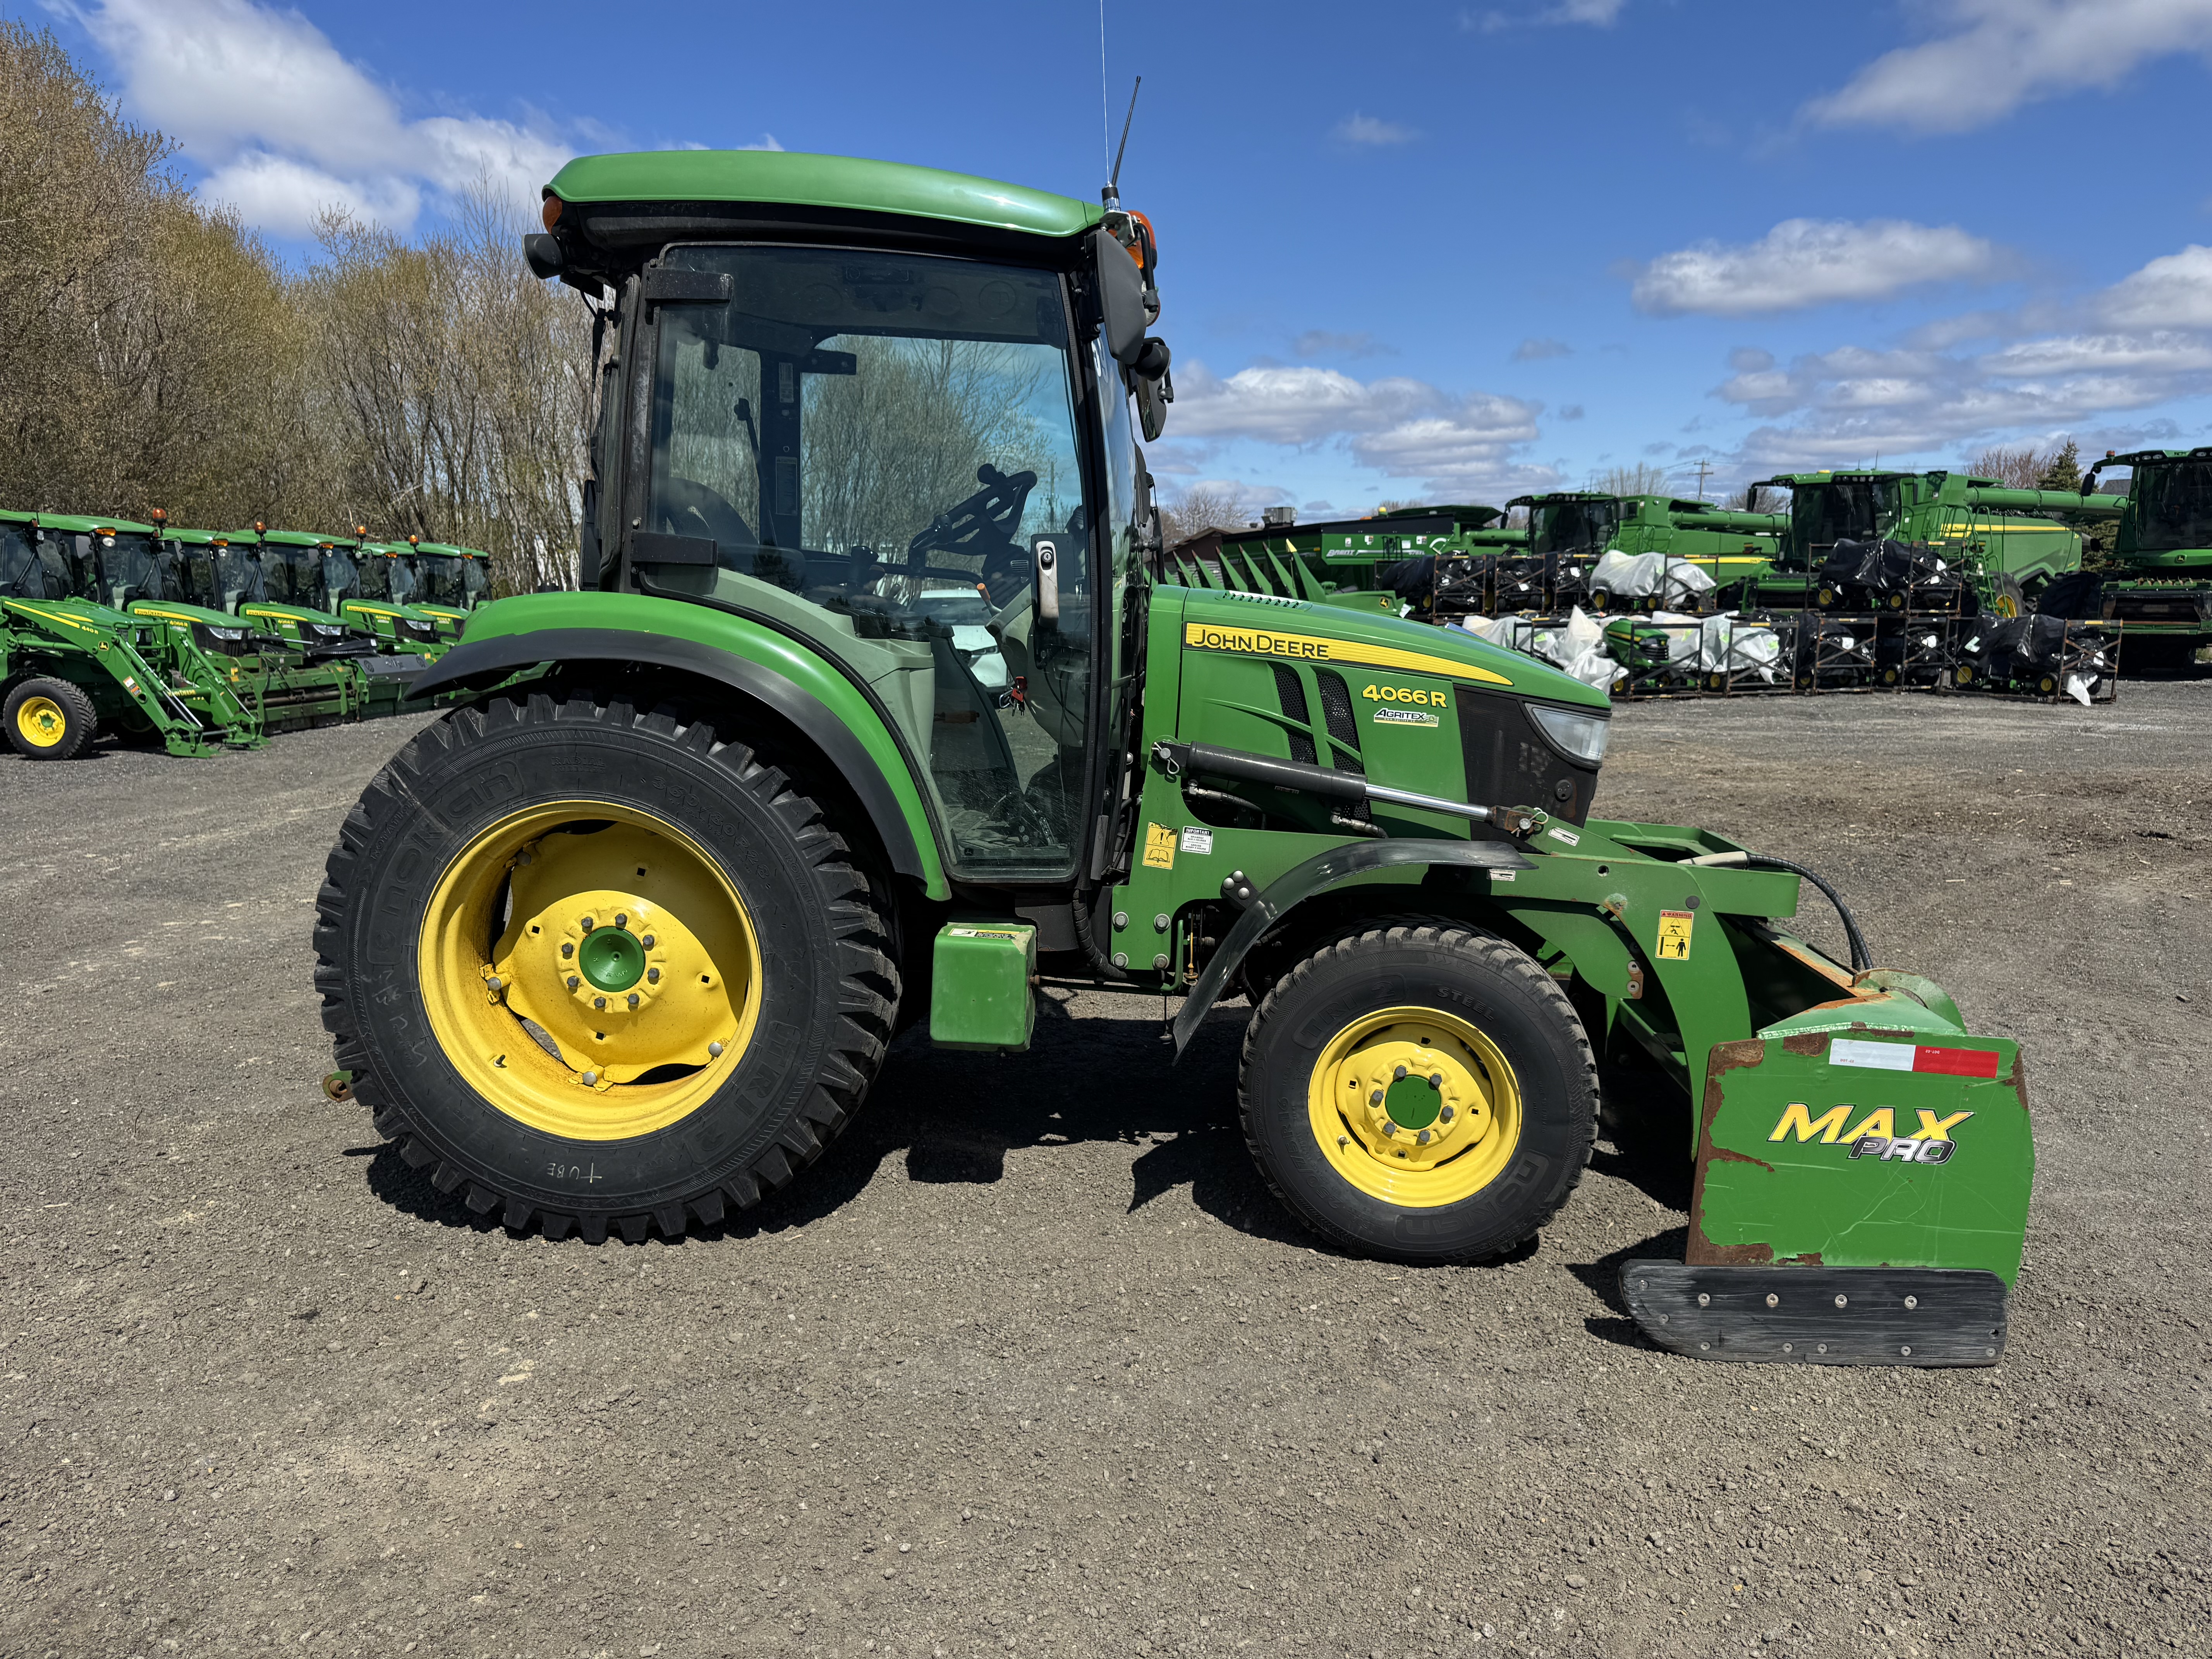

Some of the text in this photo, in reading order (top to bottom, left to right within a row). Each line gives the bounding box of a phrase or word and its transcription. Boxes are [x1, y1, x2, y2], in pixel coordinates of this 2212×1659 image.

[1194, 629, 1329, 657] JOHN DEERE
[1376, 709, 1425, 720] AGRITEX
[785, 853, 821, 927] ROTATION
[1437, 986, 1495, 1022] STEEL
[1767, 1103, 1974, 1144] MAX
[1846, 1135, 1958, 1163] PRO
